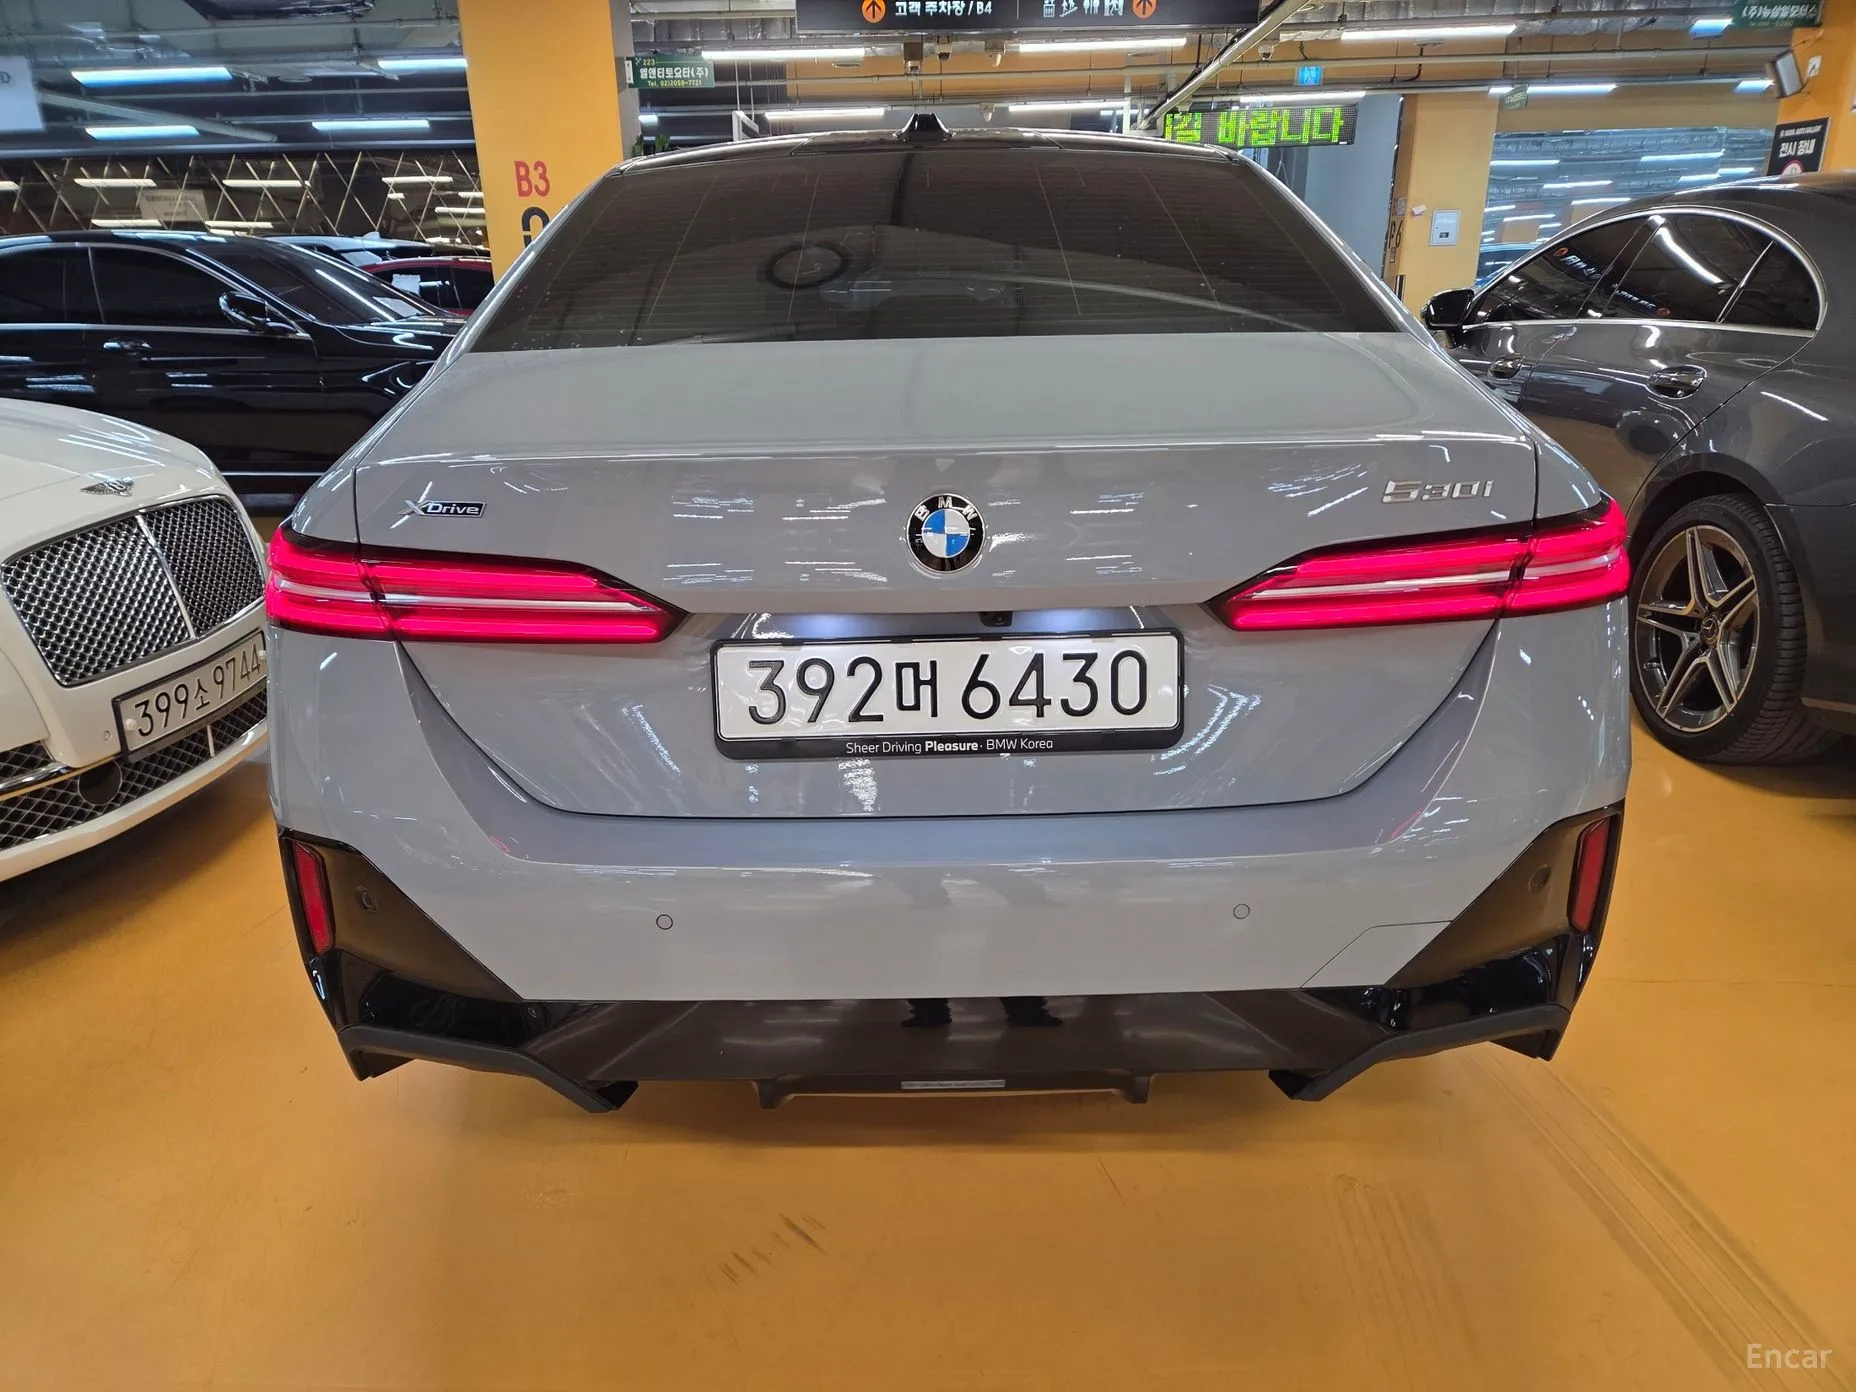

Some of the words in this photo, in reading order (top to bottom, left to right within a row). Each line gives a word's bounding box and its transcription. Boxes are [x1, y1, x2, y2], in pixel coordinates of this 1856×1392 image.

[895, 1, 921, 16] 고객
[925, 1, 966, 16] 주차장
[976, 1, 992, 15] B4
[642, 58, 656, 66] 223
[1218, 107, 1344, 147] 바랍니다
[1779, 141, 1797, 158] 전시
[514, 160, 551, 198] B3
[1382, 480, 1494, 503] 530i
[914, 496, 978, 522] BMW
[845, 742, 880, 754] Sheer
[882, 741, 922, 754] Driving
[986, 739, 1017, 750] BMW
[1020, 738, 1053, 749] Korea
